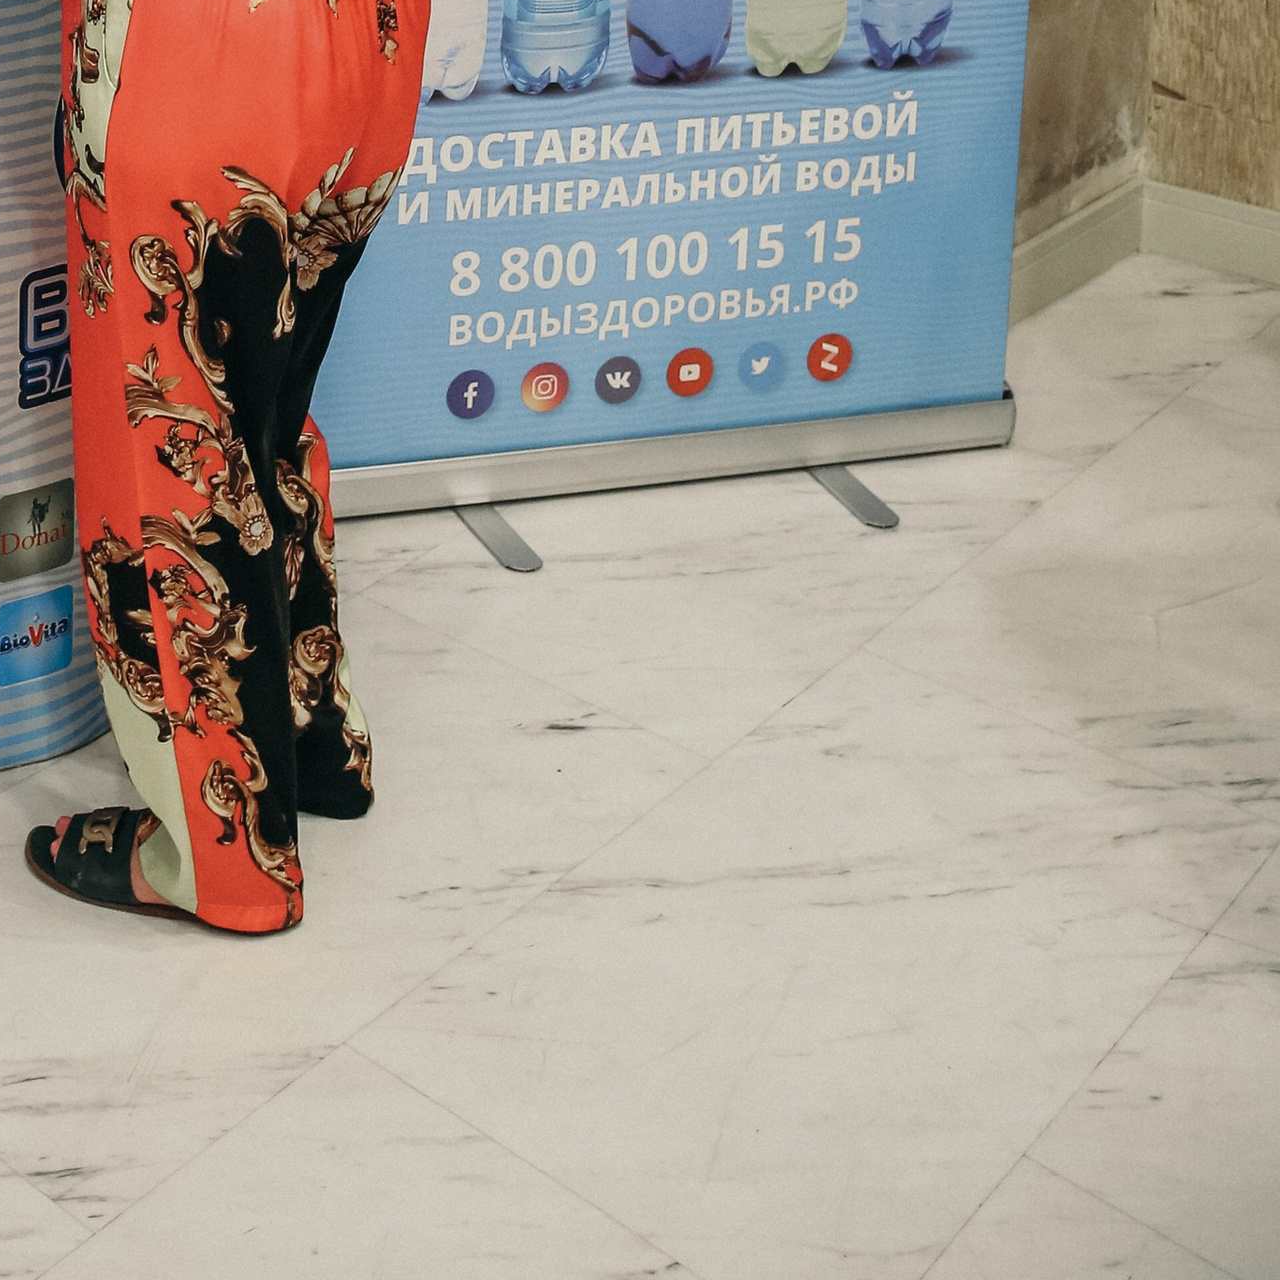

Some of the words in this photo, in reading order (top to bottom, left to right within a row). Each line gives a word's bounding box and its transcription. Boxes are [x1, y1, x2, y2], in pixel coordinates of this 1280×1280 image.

[399, 123, 662, 186] ДОСТАВКА
[676, 89, 919, 155] ПИТЬЕВОЙ
[398, 190, 428, 225] И
[445, 155, 783, 221] МИНЕРАЛЬНОЙ
[796, 151, 917, 197] ВОДЫ
[449, 251, 481, 297] 8
[498, 240, 597, 292] 800
[616, 232, 709, 282] 100
[727, 224, 785, 271] 15
[805, 217, 862, 265] 15
[448, 278, 860, 351] ВОДЫЗДОРОВЬЯ.РФ
[0, 523, 67, 558] Donat
[0, 617, 69, 655] BioVita
